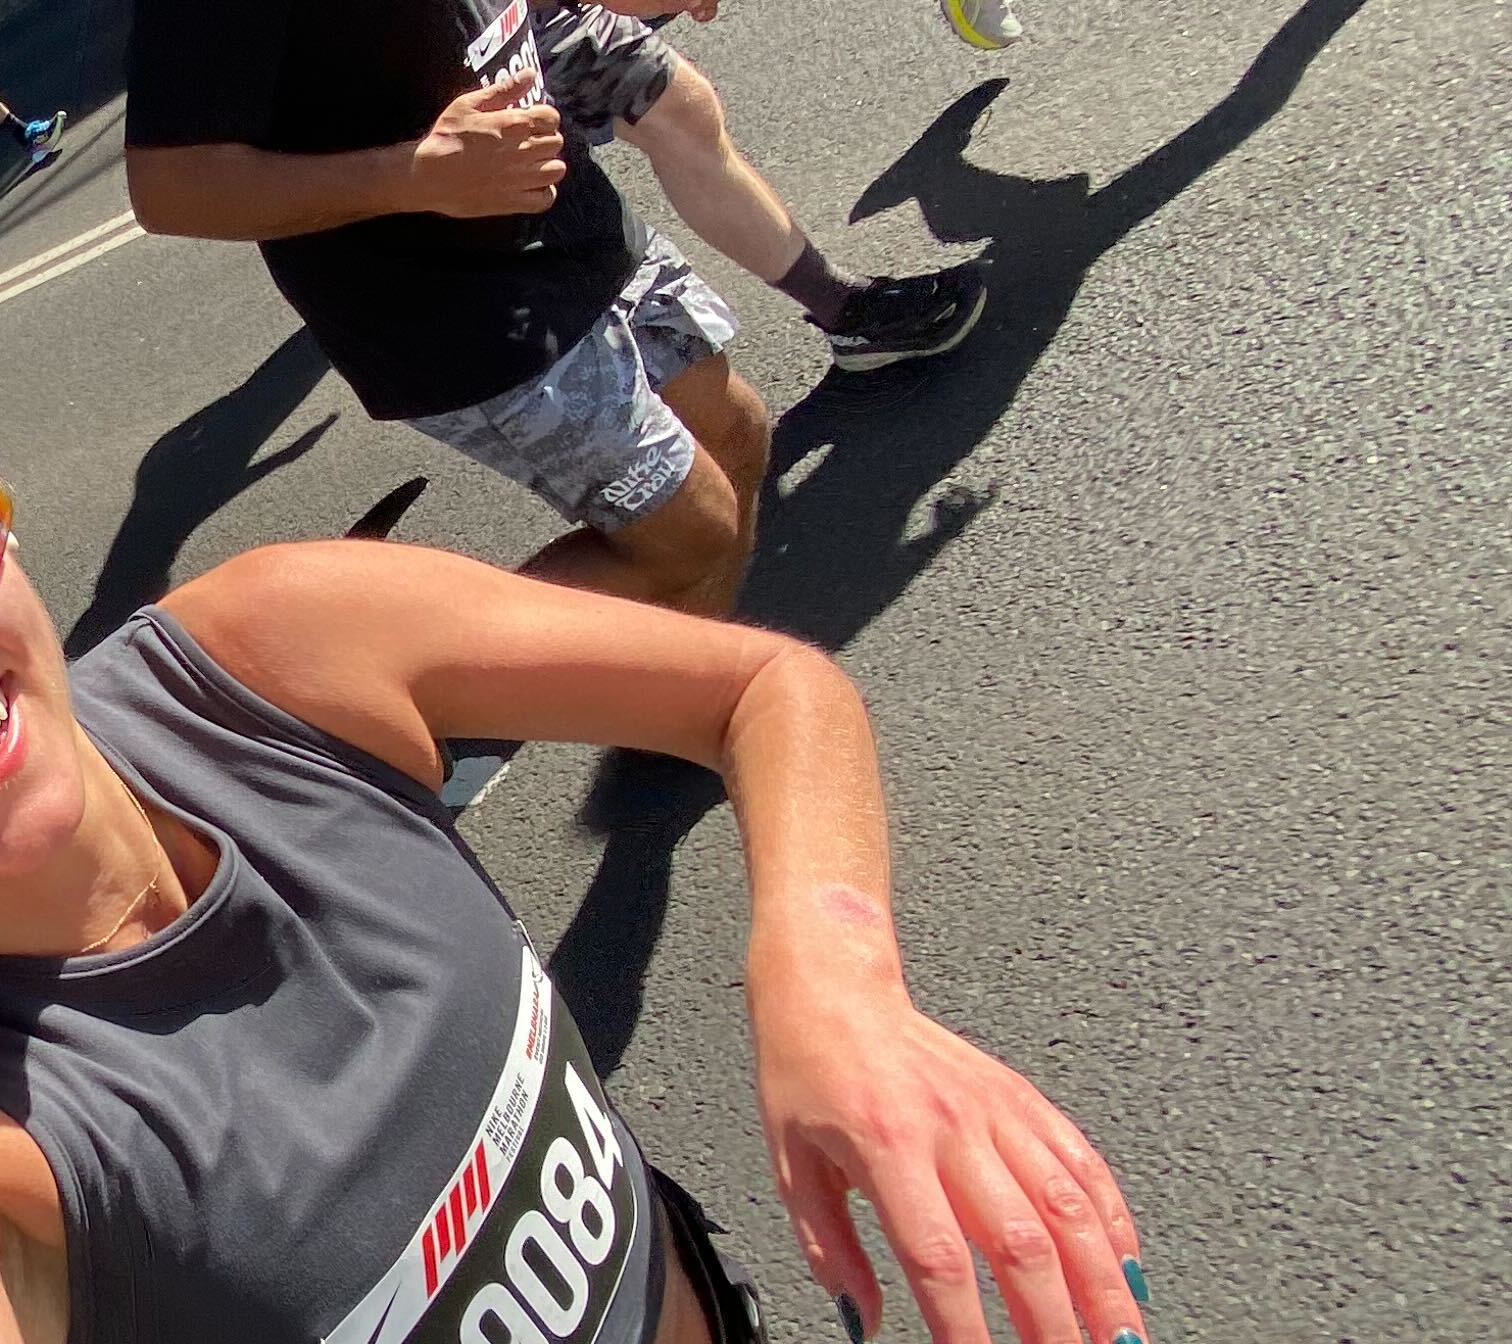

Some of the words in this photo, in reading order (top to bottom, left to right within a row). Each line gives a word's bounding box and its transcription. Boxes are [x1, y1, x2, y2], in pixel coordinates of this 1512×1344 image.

[485, 1105, 503, 1138] NIKE
[492, 1072, 525, 1147] MELBOURNE
[499, 1093, 529, 1156] MARATHON
